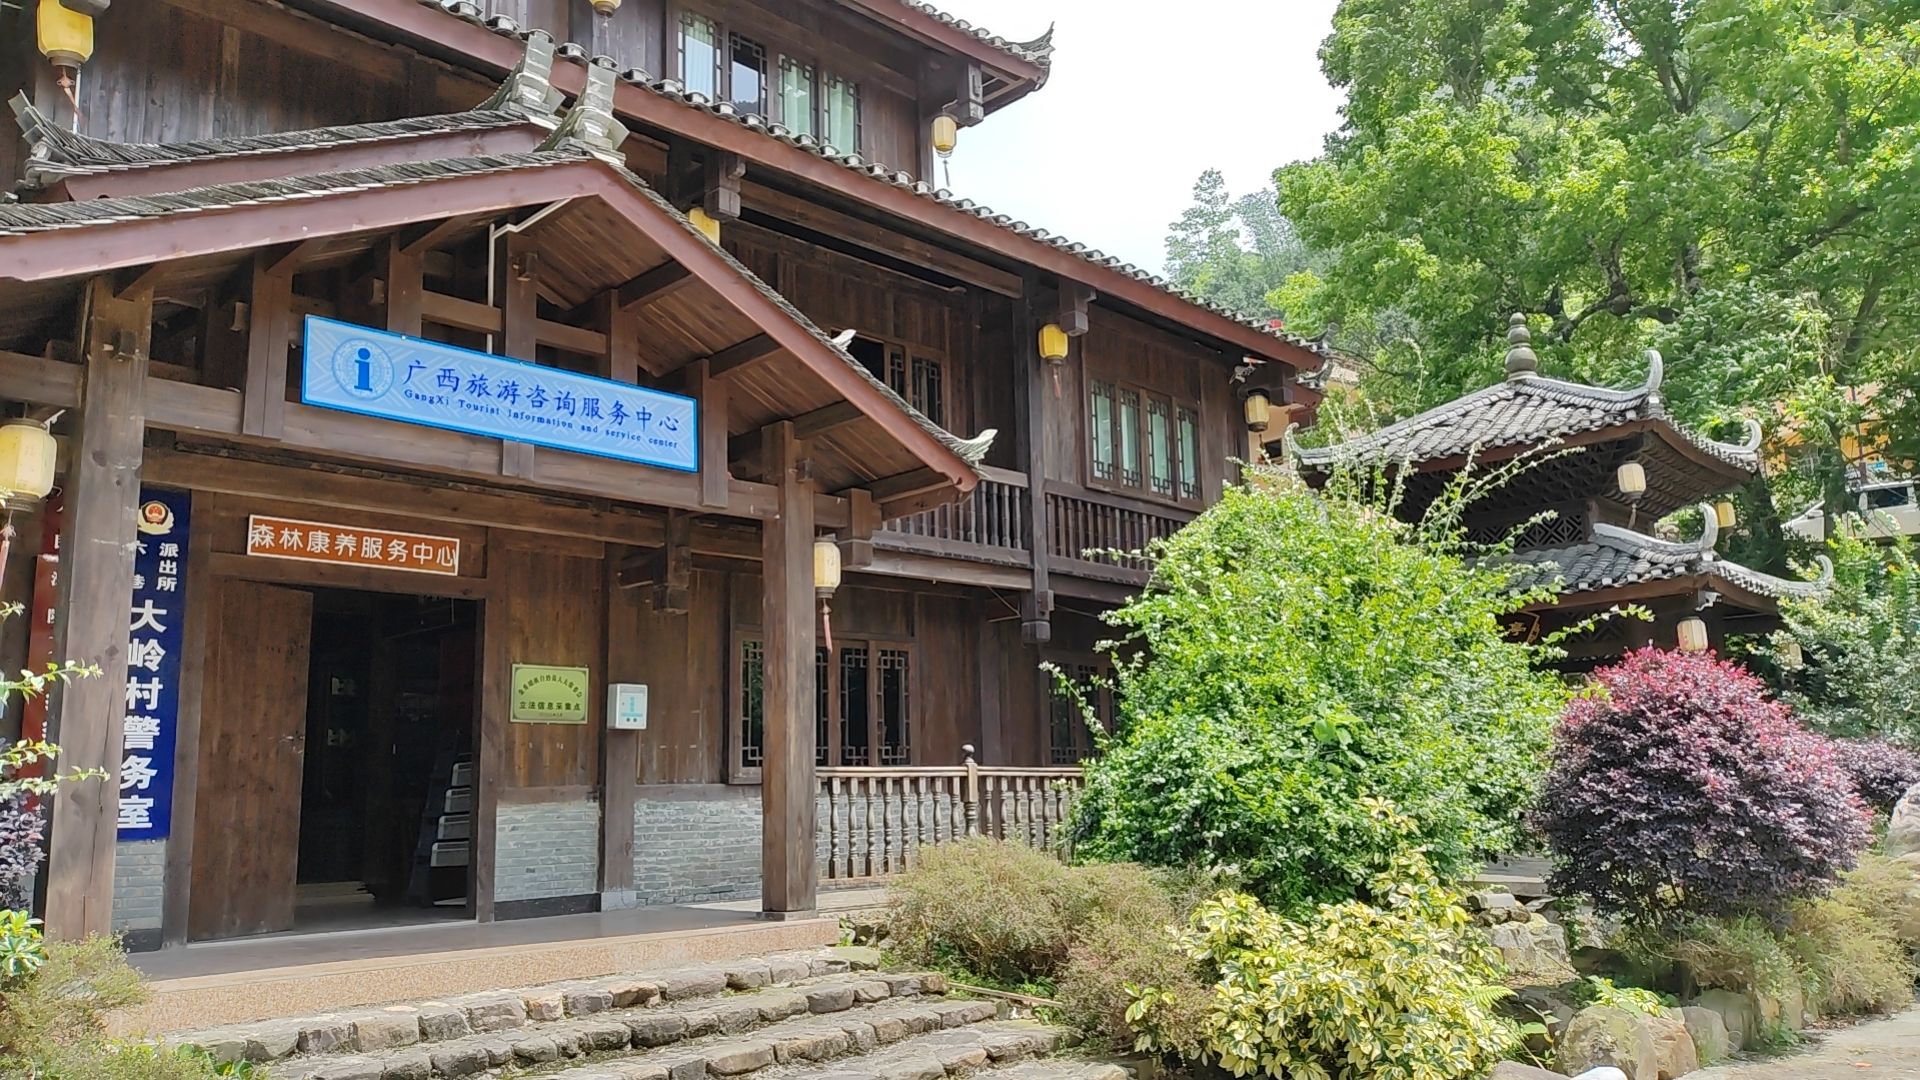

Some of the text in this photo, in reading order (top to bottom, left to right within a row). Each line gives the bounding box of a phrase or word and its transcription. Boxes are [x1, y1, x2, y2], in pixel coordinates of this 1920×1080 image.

[403, 359, 680, 432] 广西旅游咨询服务中心
[458, 399, 500, 415] Tourist
[508, 409, 573, 429] Information
[581, 424, 598, 433] and
[605, 428, 641, 442] service
[648, 437, 678, 449] center
[156, 542, 180, 592] 派出所
[250, 523, 457, 568] 森林康养服务中心
[117, 598, 168, 830] 大岭村警务室
